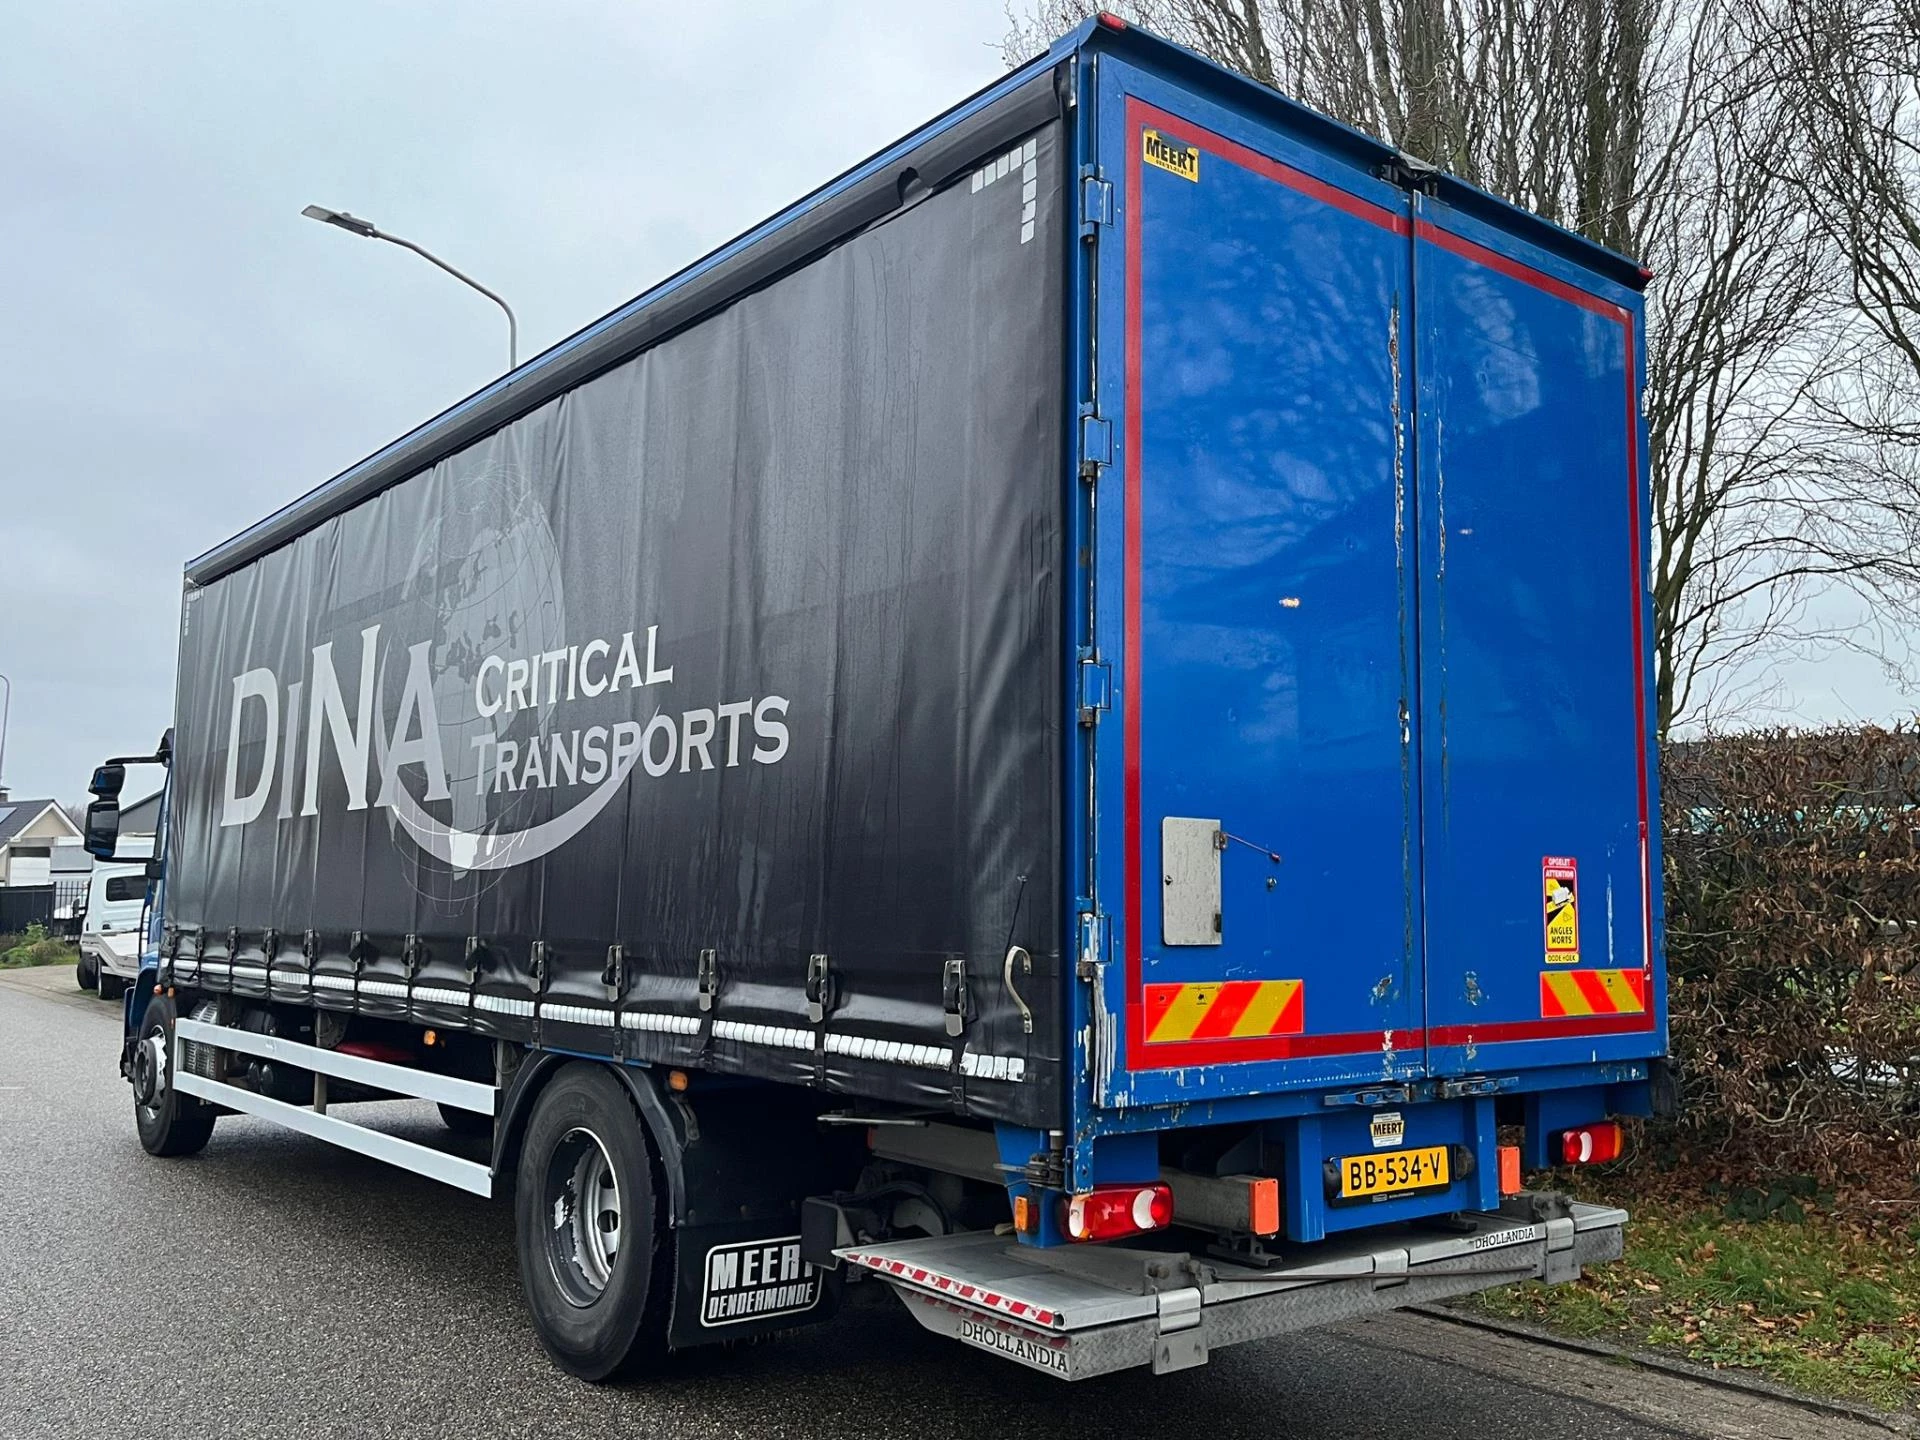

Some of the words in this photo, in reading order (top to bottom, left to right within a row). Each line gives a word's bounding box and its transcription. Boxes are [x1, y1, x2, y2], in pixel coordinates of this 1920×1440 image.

[1146, 136, 1196, 173] MEERT
[474, 624, 674, 718] CRITICAL
[470, 695, 790, 796] TRANSPORTS
[1550, 926, 1573, 935] ANGLES
[1551, 936, 1572, 944] MORTS
[1373, 1121, 1403, 1136] MEERT
[1350, 1151, 1440, 1191] BB-534-V
[1475, 1226, 1535, 1249] DHOLLANDIA
[707, 1281, 815, 1320] DENDERMONDE
[962, 1319, 1069, 1373] DHOLLANDIA
